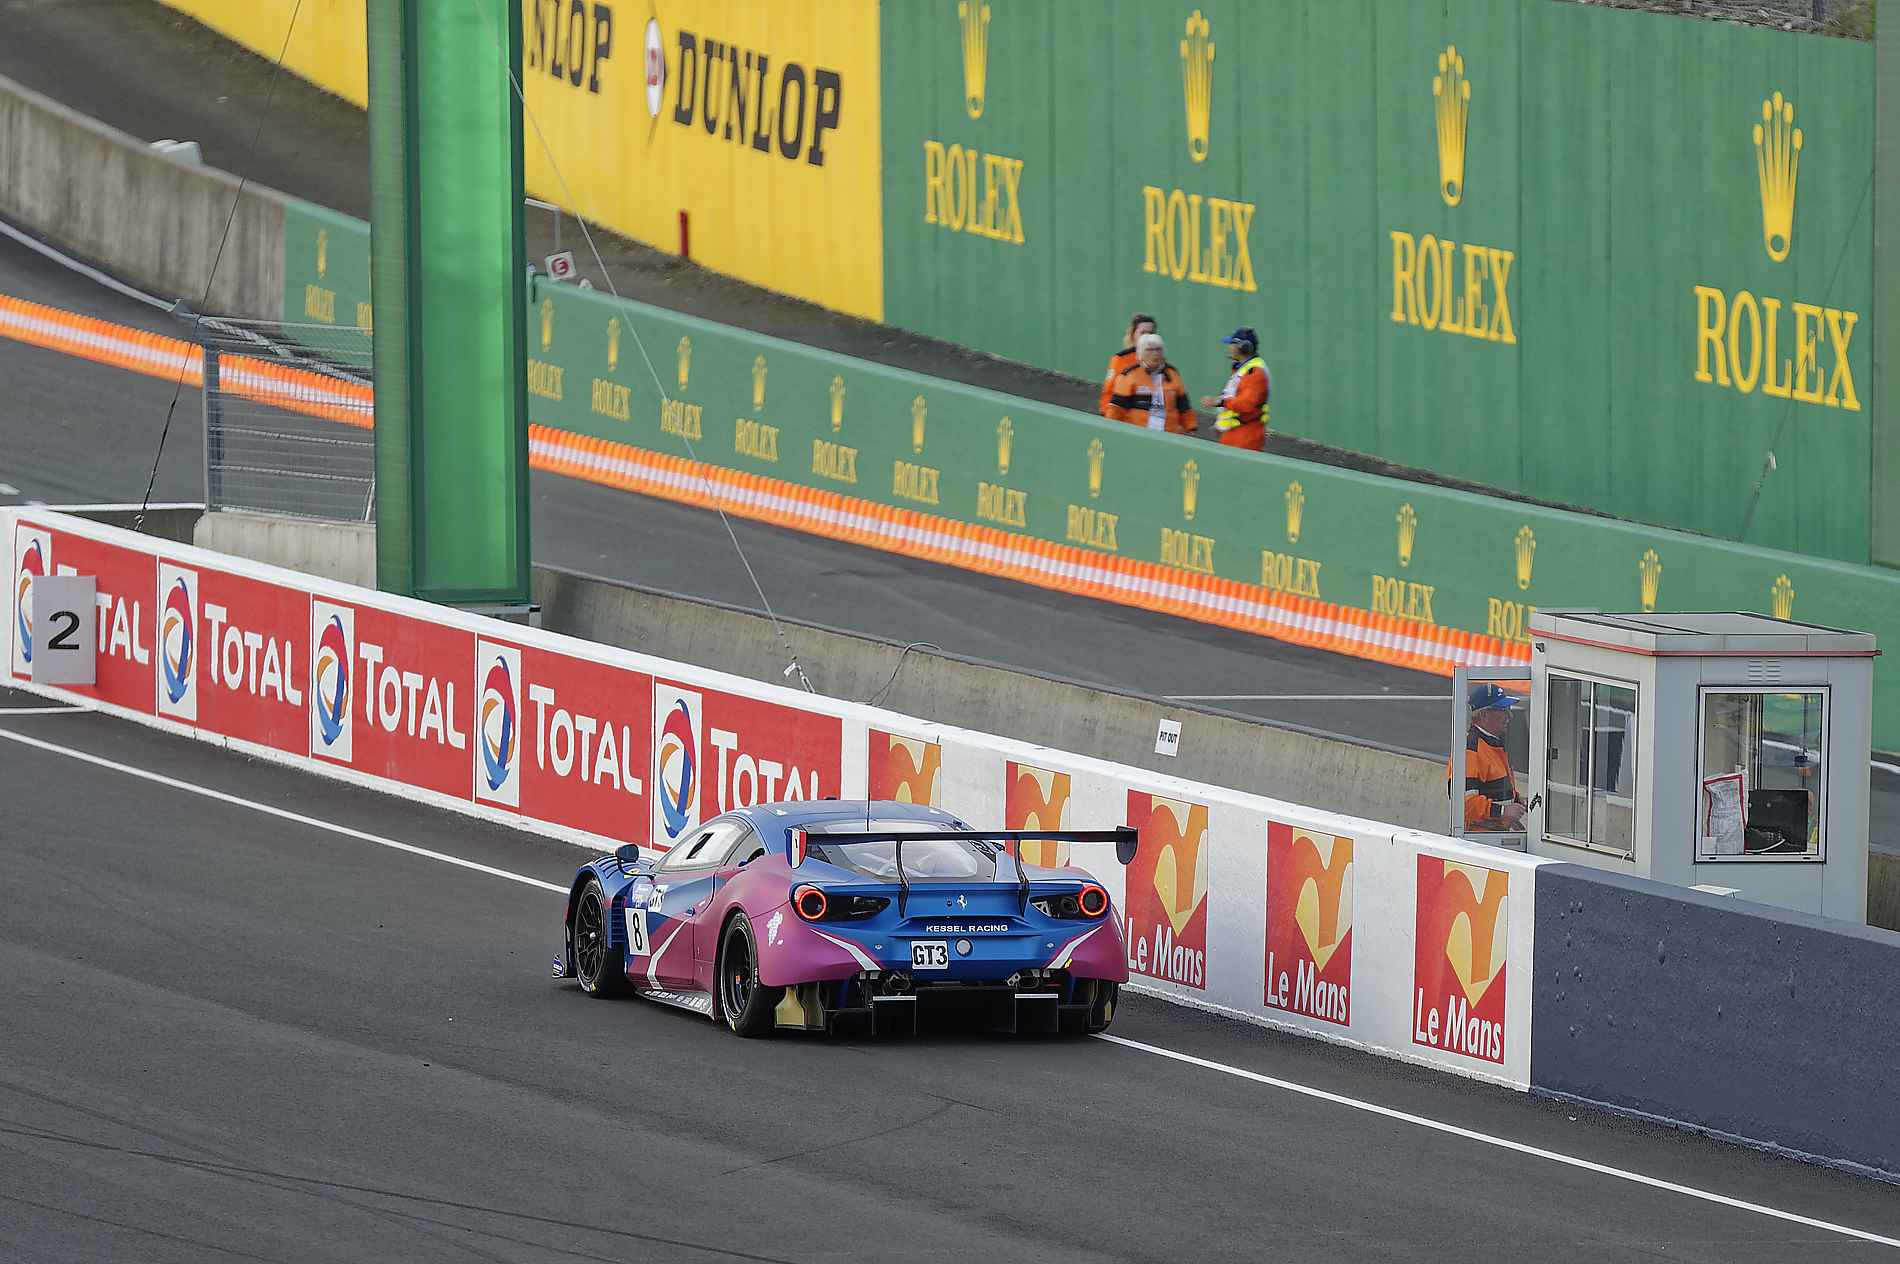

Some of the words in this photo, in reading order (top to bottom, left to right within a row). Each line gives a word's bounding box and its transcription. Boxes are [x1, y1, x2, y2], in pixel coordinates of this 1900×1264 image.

[674, 30, 841, 167] DUNLOP
[924, 140, 1025, 245] ROLEX
[1142, 186, 1257, 293] ROLEX
[1391, 230, 1517, 345] ROLEX
[1694, 285, 1862, 412] ROLEX
[592, 378, 631, 421] ROLEX
[661, 399, 703, 440] ROLEX
[735, 418, 780, 463] ROLEX
[812, 438, 858, 484] ROLEX
[892, 460, 940, 505] ROLEX
[976, 482, 1028, 528] ROLEX
[1067, 504, 1119, 551] ROLEX
[1160, 527, 1215, 576] ROLEX
[1262, 550, 1322, 599] ROLEX
[1371, 574, 1435, 624] ROLEX
[48, 610, 80, 650] 2
[1487, 596, 1537, 644] ROL
[205, 603, 302, 707] TOTAL
[360, 641, 465, 750] TOTAL
[529, 683, 642, 796] TOTAL
[1159, 730, 1168, 742] PIT
[1167, 732, 1178, 744] OUT
[632, 912, 643, 952] 8
[926, 925, 966, 933] KESSEL
[968, 924, 1009, 932] RACING
[1127, 917, 1148, 972] Le
[1152, 923, 1204, 986] Mans
[912, 945, 947, 966] GT3
[1267, 951, 1289, 1008] Le
[1294, 958, 1348, 1022] Mans
[1415, 987, 1440, 1045] Le
[1444, 994, 1502, 1060] Mans
